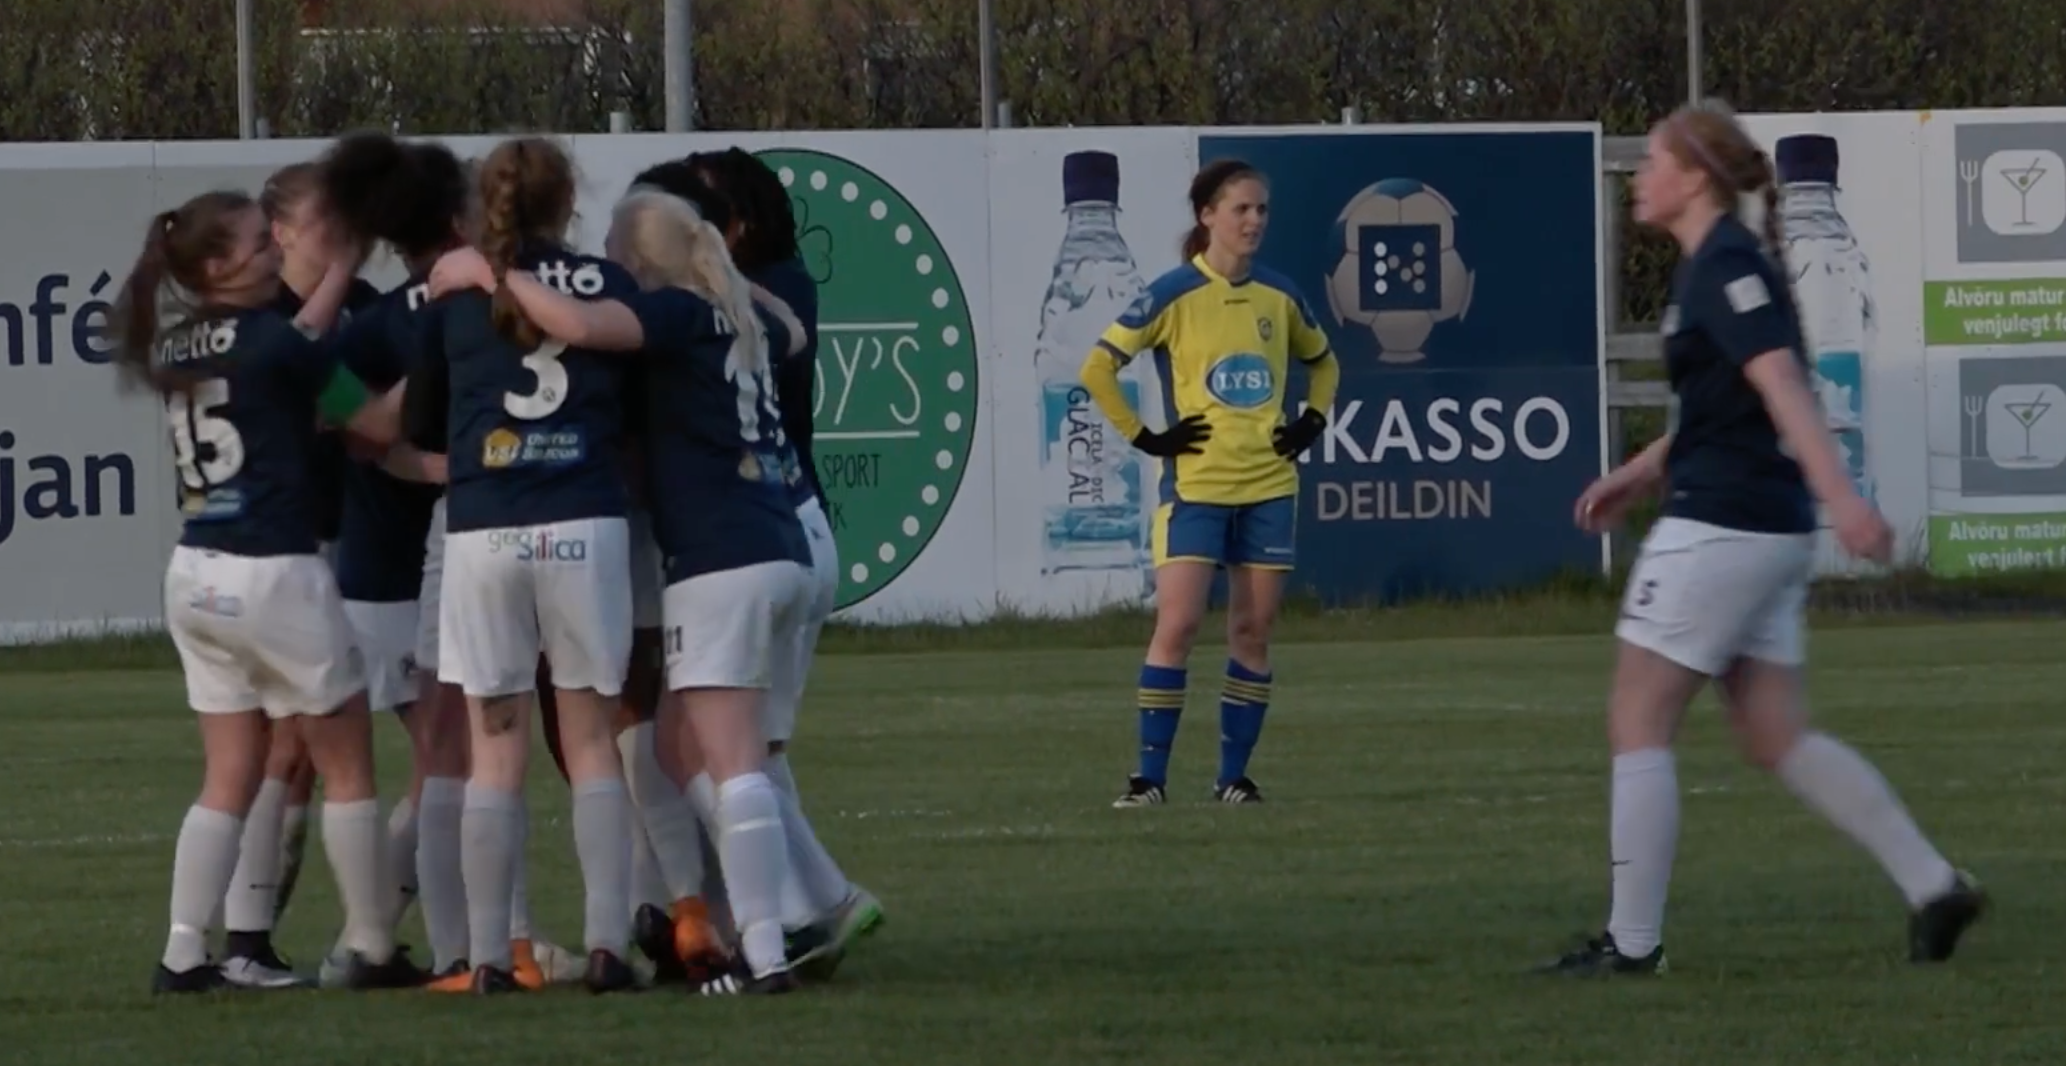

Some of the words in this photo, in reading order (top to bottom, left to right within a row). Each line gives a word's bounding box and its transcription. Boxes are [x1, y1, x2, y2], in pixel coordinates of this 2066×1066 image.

[537, 260, 604, 295] ttó
[1944, 286, 2005, 308] Alvöru
[2010, 285, 2065, 306] matur
[1962, 312, 2050, 339] venjulegt
[503, 340, 569, 421] 3
[812, 336, 921, 425] Y'S
[170, 377, 246, 488] 15
[1067, 386, 1091, 504] GLACAL
[1298, 397, 1570, 463] KASSO
[822, 453, 882, 490] SPORT
[1316, 480, 1492, 521] DEILDIN
[1949, 521, 2009, 541] Alvöru
